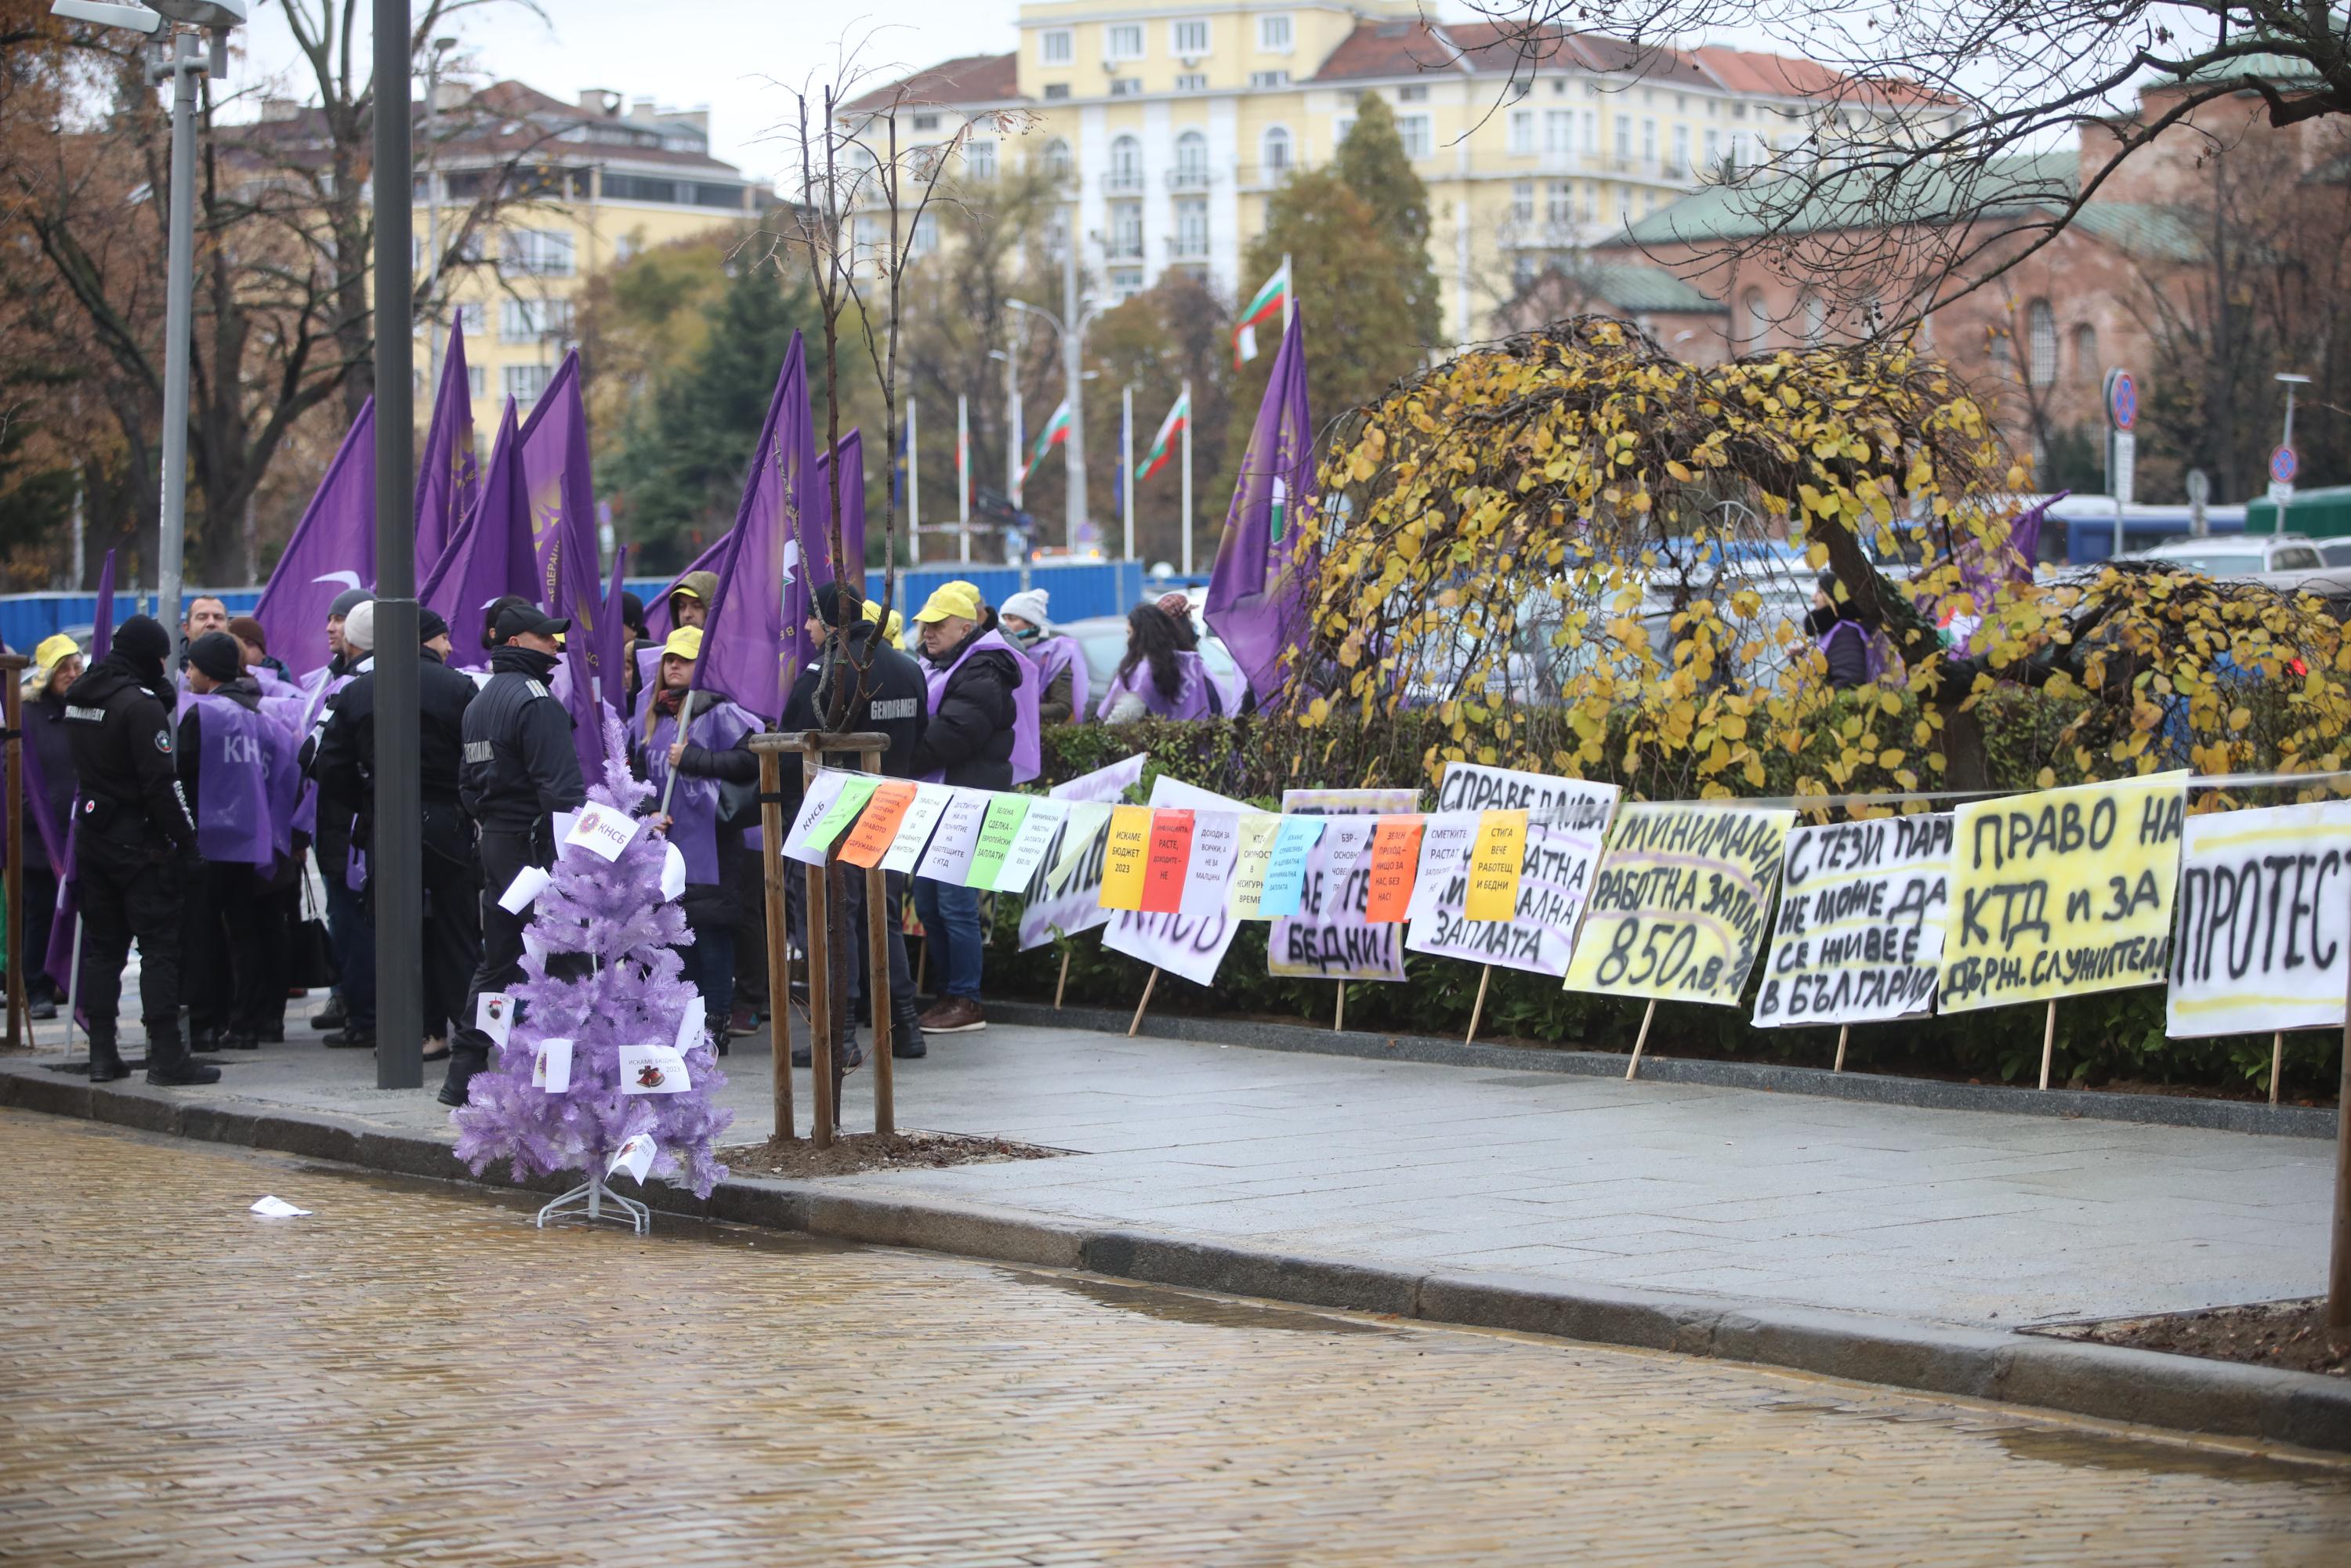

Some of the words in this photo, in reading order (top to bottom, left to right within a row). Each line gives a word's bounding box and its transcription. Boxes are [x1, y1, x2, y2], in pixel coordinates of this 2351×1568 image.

[802, 801, 824, 831] КНСБ
[996, 806, 1014, 816] ЗЕЛЕНА
[1031, 813, 1059, 822] МИНИМАЛНА
[862, 821, 886, 833] ПРАВОТО
[987, 820, 1009, 831] СДЕЛКА
[597, 821, 627, 845] КНСБ
[1115, 830, 1142, 842] ИСКАМЕ
[1201, 829, 1223, 839] ДОХОДИ
[1341, 833, 1353, 843] БЗР
[1386, 831, 1406, 841] ЗЕЛЕН
[1431, 829, 1467, 839] СМЕТКИТЕ
[1491, 827, 1513, 838] СТИГА
[1973, 795, 2117, 871] ПРАВО
[2139, 794, 2183, 846] НА
[1158, 839, 1179, 850] РАСТЕ,
[1111, 846, 1141, 858] БЮДЖЕТ
[1378, 846, 1401, 856] ПРЕХОД
[1491, 846, 1508, 855] ВЕЧЕ
[1787, 830, 1812, 885] С
[1818, 824, 1885, 870] ТЕЗИ
[936, 858, 950, 868] КТД
[1153, 856, 1177, 864] ДОХОДИТЕ
[1114, 863, 1131, 873] 2023
[1376, 862, 1395, 871] НИЩО
[1395, 861, 1404, 870] ЗА
[1477, 862, 1513, 874] РАБОТЕЩ
[1160, 871, 1168, 880] НЕ
[1388, 877, 1400, 885] БЕЗ
[1269, 883, 1288, 892] ЗАПЛАТА
[1476, 880, 1483, 889] И
[1483, 880, 1509, 892] БЕДНИ
[1592, 867, 1698, 911] РАБОТНА
[1378, 892, 1392, 901] НАС!
[1778, 896, 1811, 936] НЕ
[1814, 878, 1888, 925] МОЖЕ
[1886, 877, 1947, 932] ДА
[1960, 878, 2051, 953] КТД
[2102, 869, 2160, 922] ЗА
[1431, 910, 1542, 965] ЗАПЛАТА
[1288, 922, 1393, 974] БЕДНИ!
[1777, 941, 1809, 974] СЕ
[1819, 927, 1922, 968] ЖИВЕЕ
[1939, 956, 2027, 1006] ДЪРЖ.
[1761, 980, 1780, 1016] В
